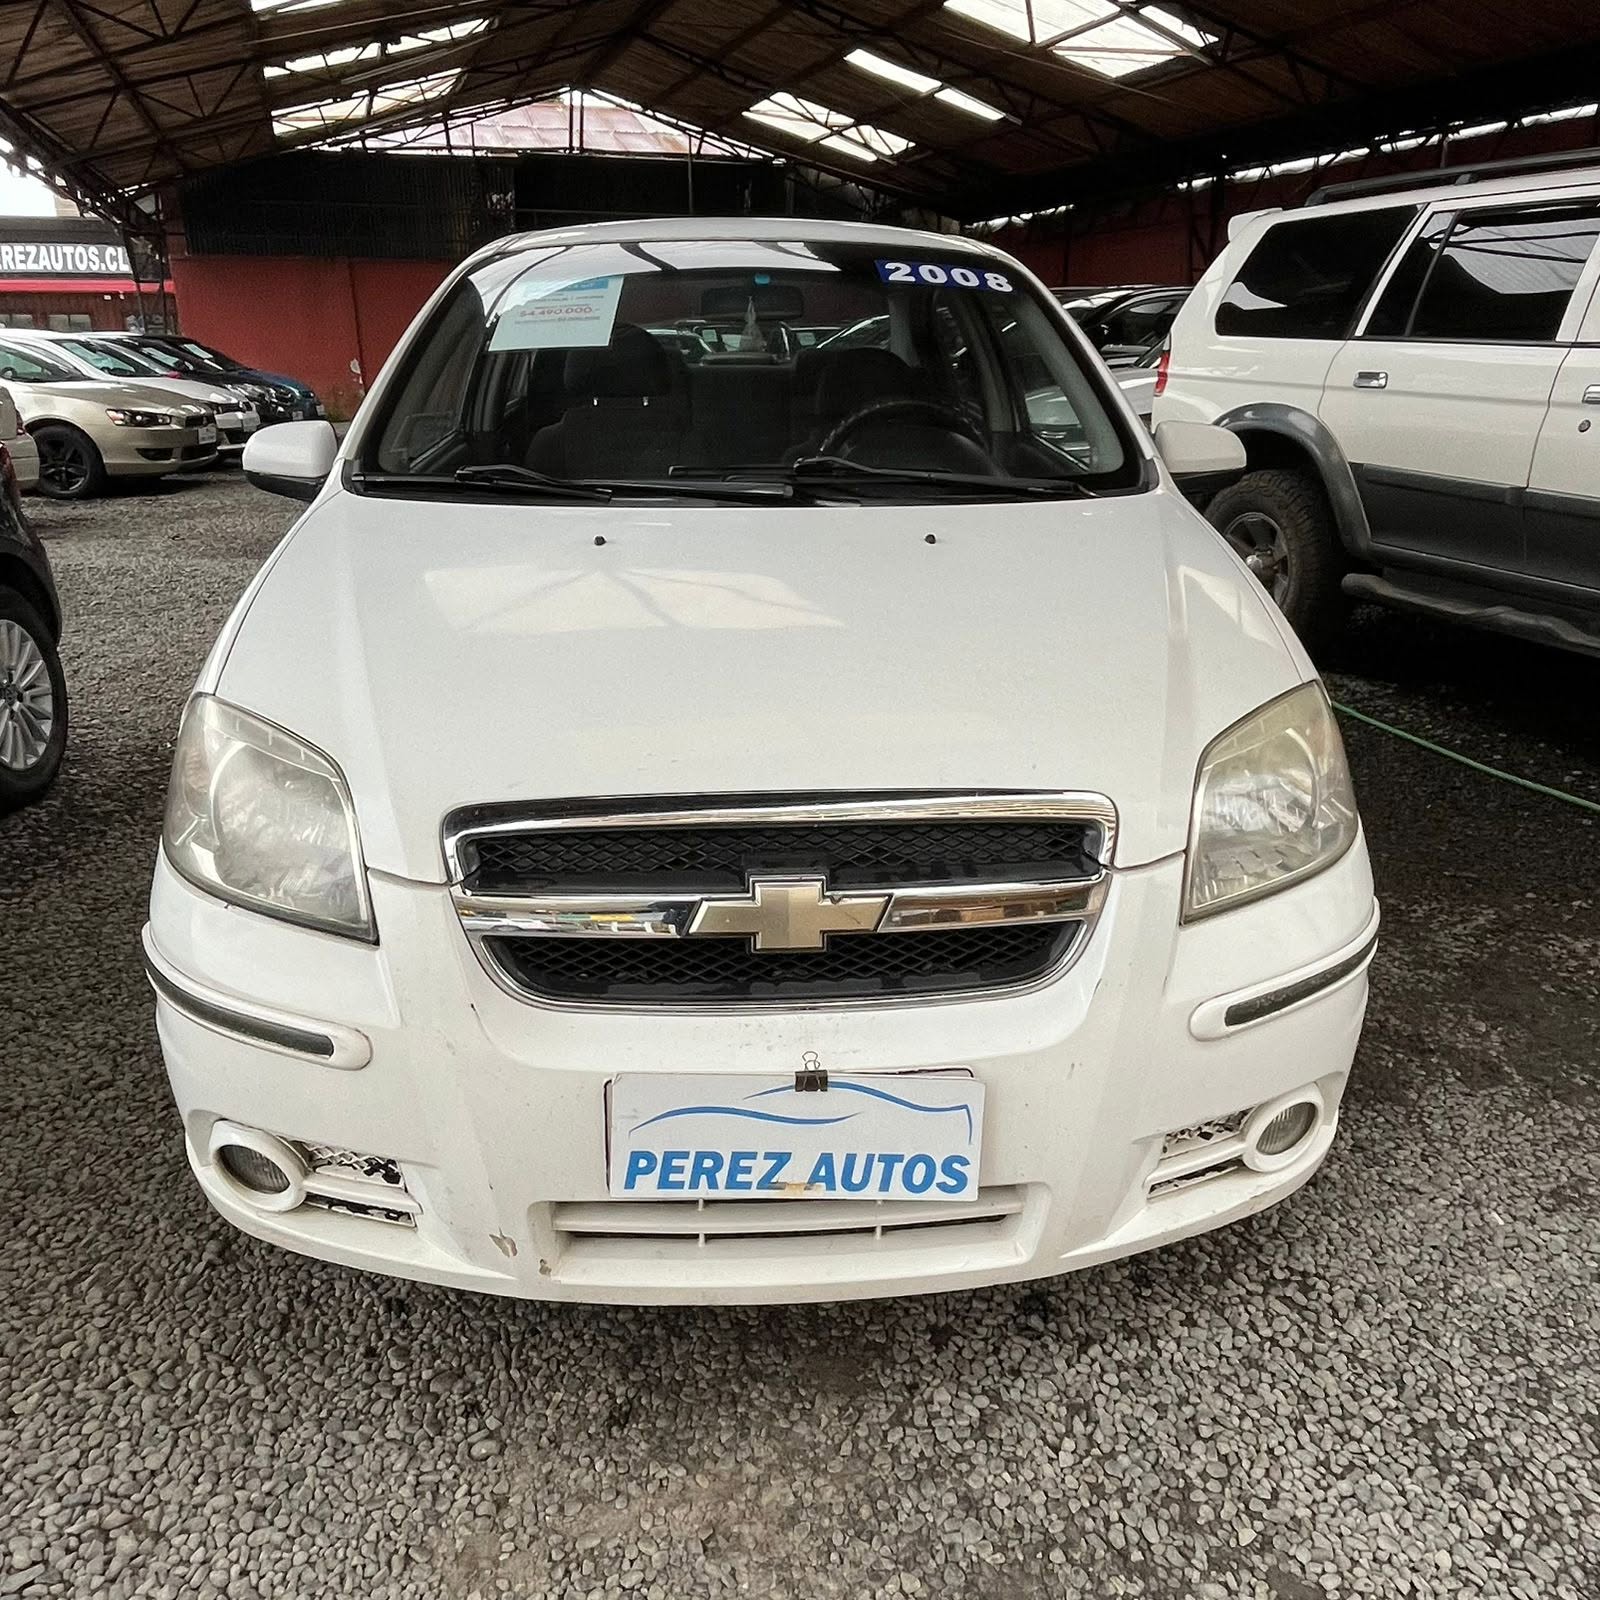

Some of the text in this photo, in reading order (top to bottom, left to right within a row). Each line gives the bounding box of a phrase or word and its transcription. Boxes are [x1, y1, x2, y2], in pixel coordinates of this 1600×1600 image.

[0, 245, 130, 271] REZAUTOS.CL
[885, 262, 1013, 293] 2008
[623, 1150, 972, 1195] PEREZ AUTOS
